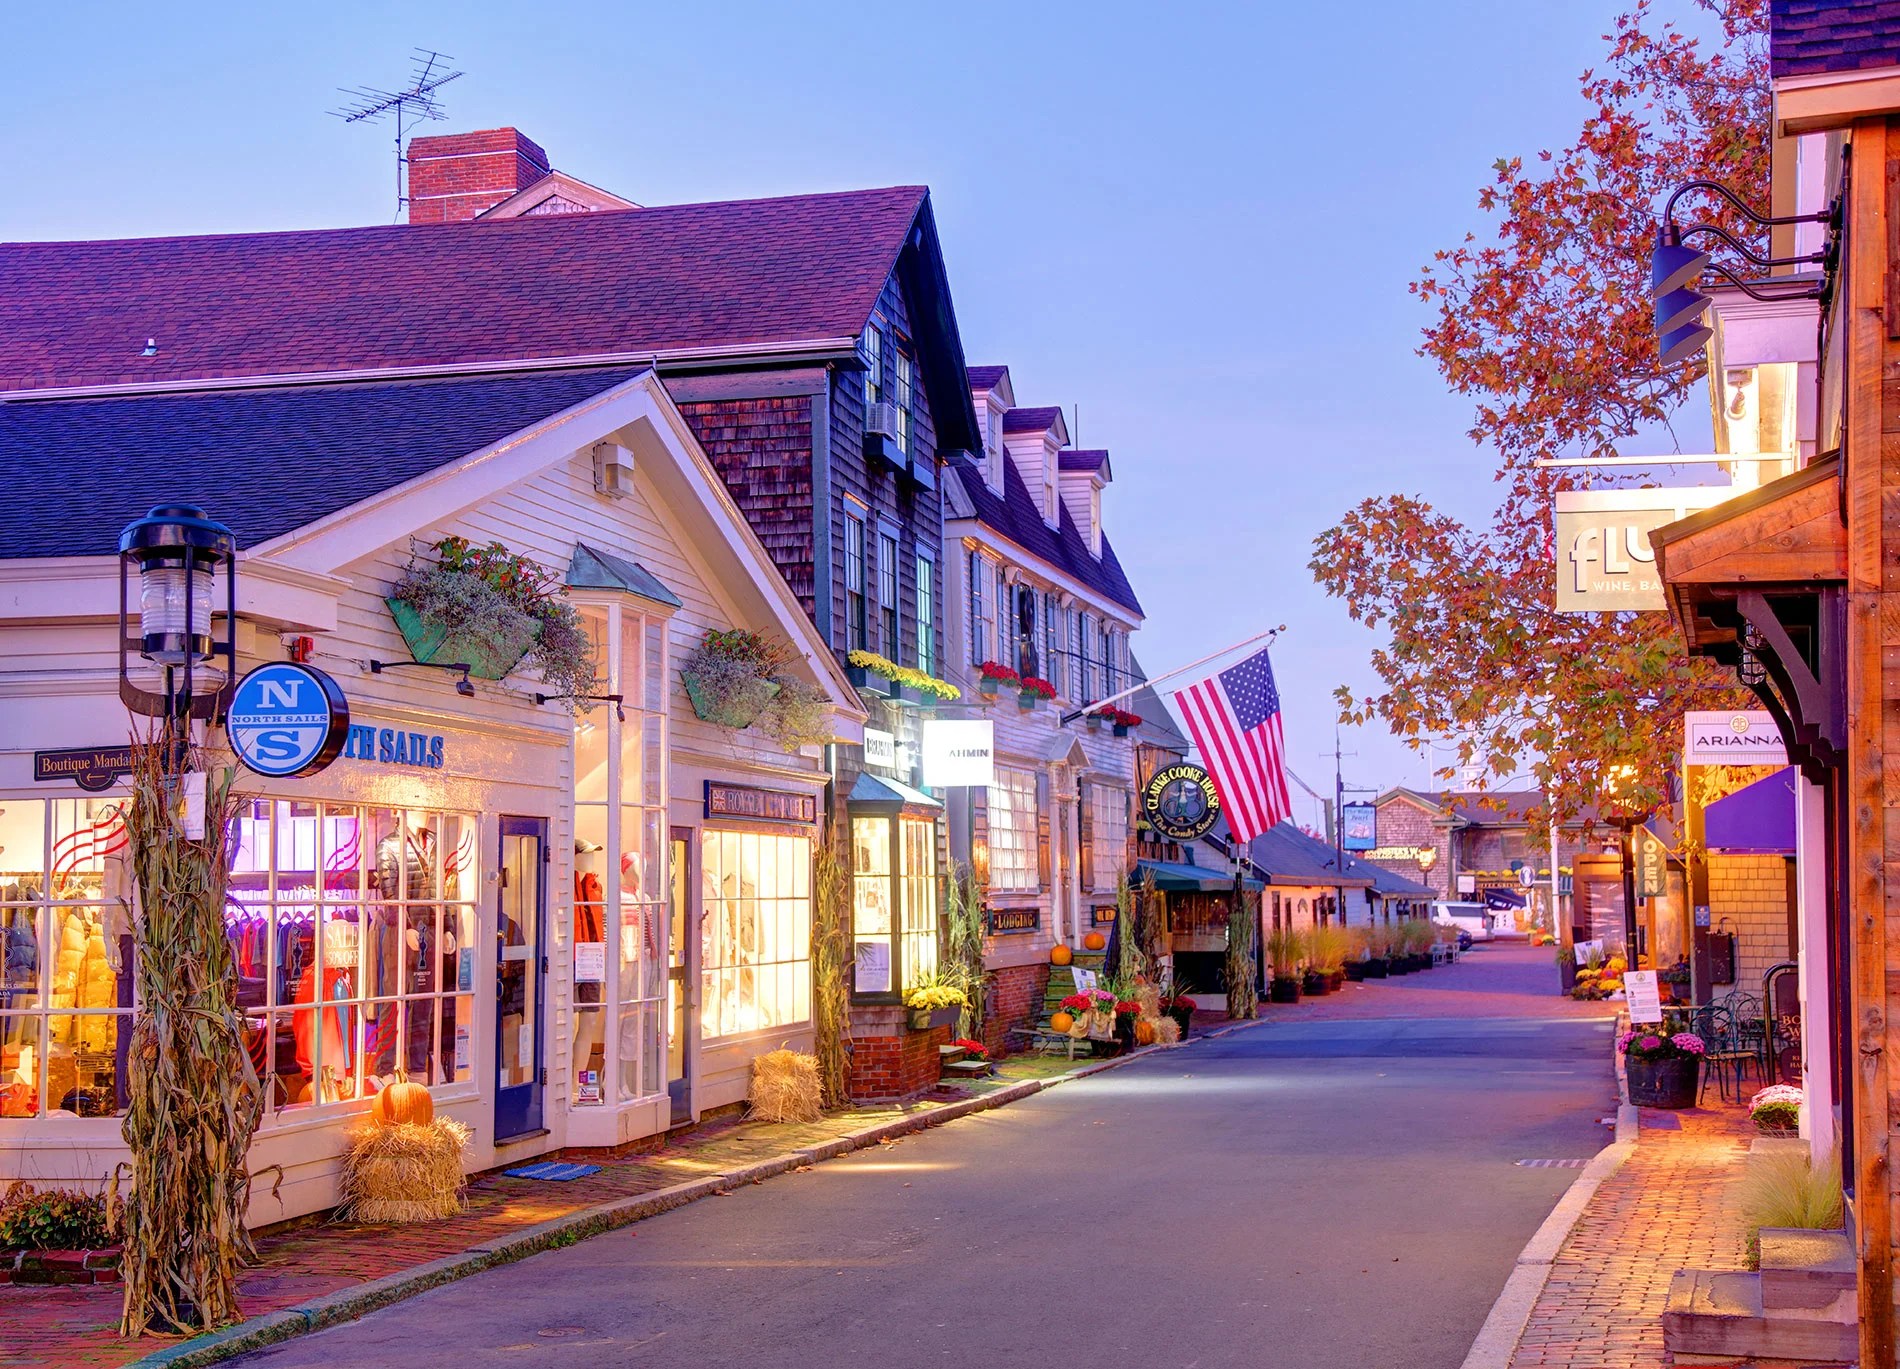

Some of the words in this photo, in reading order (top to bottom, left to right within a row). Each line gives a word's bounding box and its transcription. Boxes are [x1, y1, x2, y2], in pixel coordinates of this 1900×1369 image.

[1593, 580, 1634, 593] WINE,
[1640, 580, 1664, 592] BA
[256, 679, 304, 709] N
[232, 715, 282, 723] NORTH
[285, 714, 328, 723] SAILS
[256, 731, 301, 761] S
[379, 728, 445, 769] SAILS
[1696, 735, 1784, 747] ARIANNA
[42, 757, 91, 773] Boutique
[1147, 772, 1171, 810] CLARKE
[1168, 766, 1203, 783] COOKE
[1199, 776, 1220, 809] HOUSE
[1153, 813, 1168, 831] The
[1167, 826, 1196, 838] Candy
[1195, 813, 1215, 834] Store
[1643, 839, 1658, 894] OPEN
[997, 913, 1034, 929] LODGING
[326, 925, 359, 949] SALE
